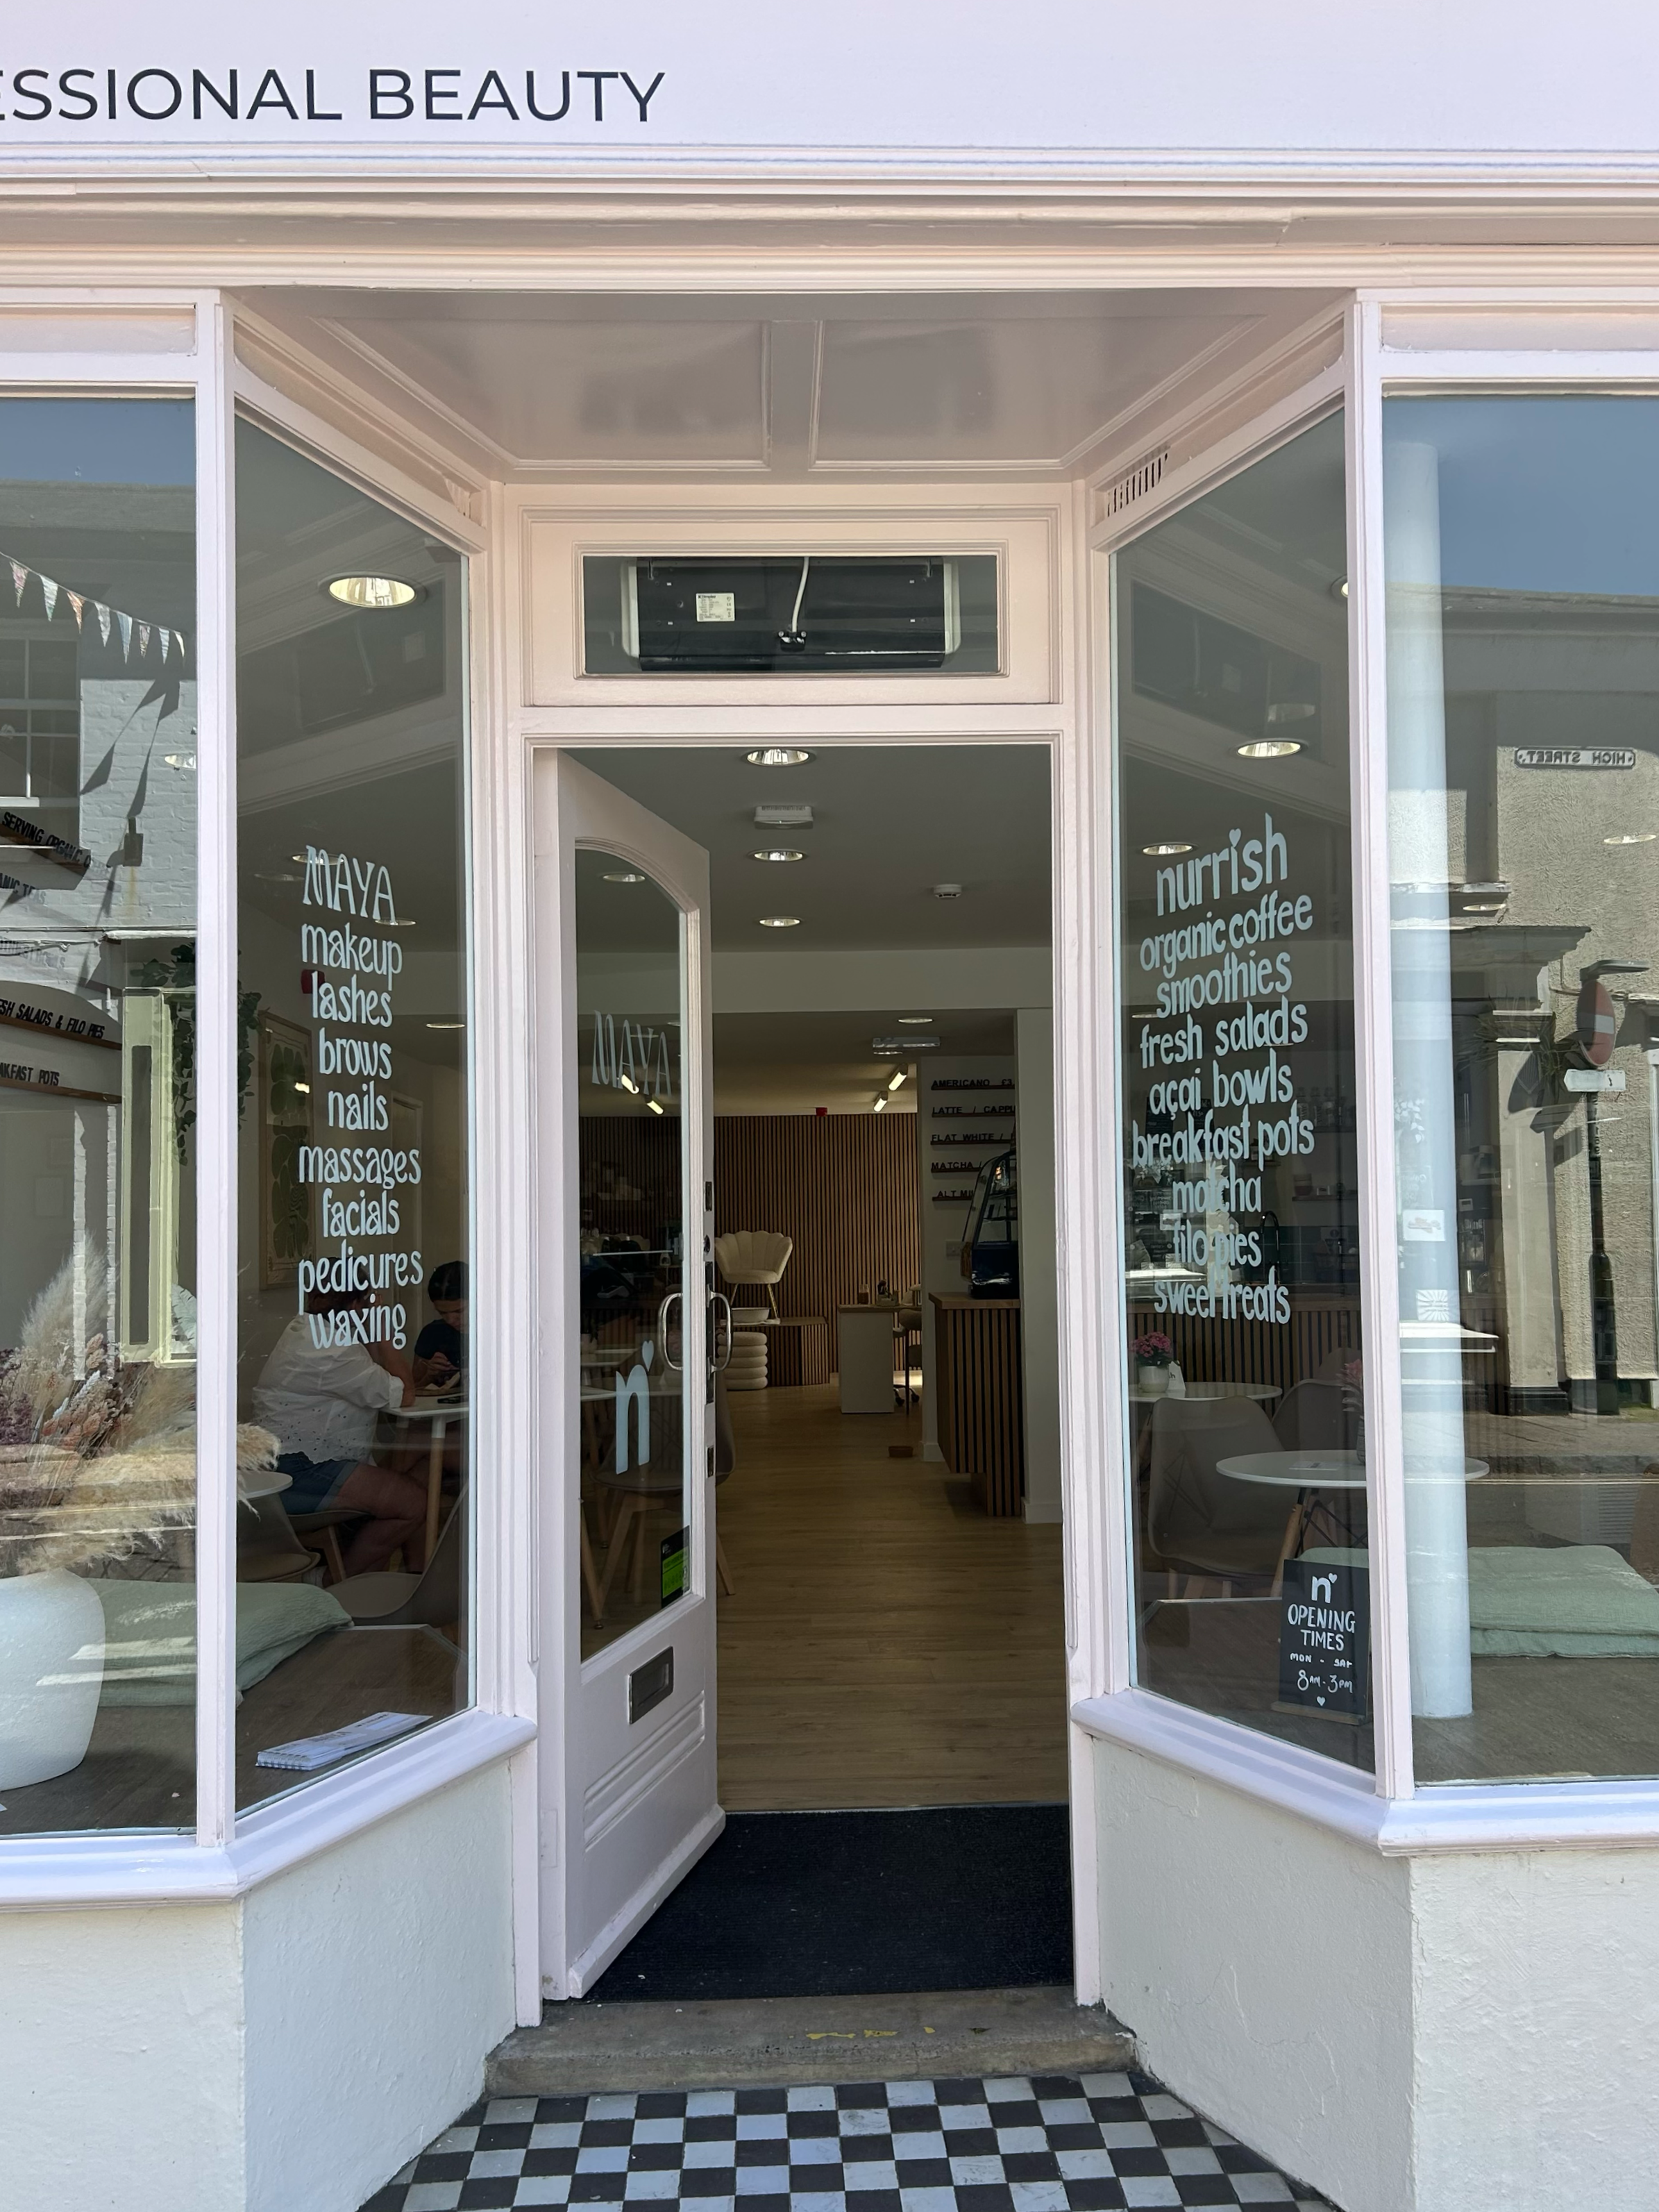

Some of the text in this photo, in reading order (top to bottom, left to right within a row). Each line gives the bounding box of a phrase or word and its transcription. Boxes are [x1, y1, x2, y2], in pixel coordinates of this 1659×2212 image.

[0, 68, 666, 122] SSIONAL BEAUTY
[2, 812, 44, 843] SERVING
[302, 845, 397, 925] MAYA
[1156, 813, 1288, 916] nurrish
[301, 923, 403, 991] makeup
[1140, 889, 1313, 979] organic coffee
[312, 971, 392, 1028] lashes
[1156, 950, 1292, 1019] smoothies
[16, 1003, 53, 1026] SALADS
[56, 1014, 64, 1029] &
[66, 1017, 86, 1034] FILO
[1140, 994, 1308, 1069] fresh salads
[38, 1069, 60, 1086] POTS
[319, 1027, 393, 1080] brows
[591, 1009, 672, 1098] MAYA
[328, 1080, 389, 1131] nails
[932, 1079, 991, 1087] AMERICANO
[932, 1106, 963, 1114] LATTE
[1149, 1066, 1202, 1120] açai
[1213, 1047, 1294, 1108] bowls
[932, 1133, 957, 1142] FLAT
[963, 1132, 994, 1141] WHITE
[1132, 1103, 1250, 1168] breakfast
[1258, 1100, 1315, 1171] pots
[298, 1145, 422, 1190] massages
[931, 1162, 974, 1170] MATCHA
[1172, 1159, 1262, 1213] matcha
[321, 1188, 401, 1238] facials
[938, 1190, 956, 1198] ALT
[298, 1239, 423, 1316] pedicures
[1173, 1219, 1263, 1282] filo pies
[308, 1293, 407, 1350] waxing
[1154, 1265, 1291, 1324] sweet treats
[616, 1364, 650, 1475] n
[1288, 1604, 1356, 1633] OPENING
[1300, 1629, 1345, 1652] TIMES
[1290, 1652, 1313, 1664] MON
